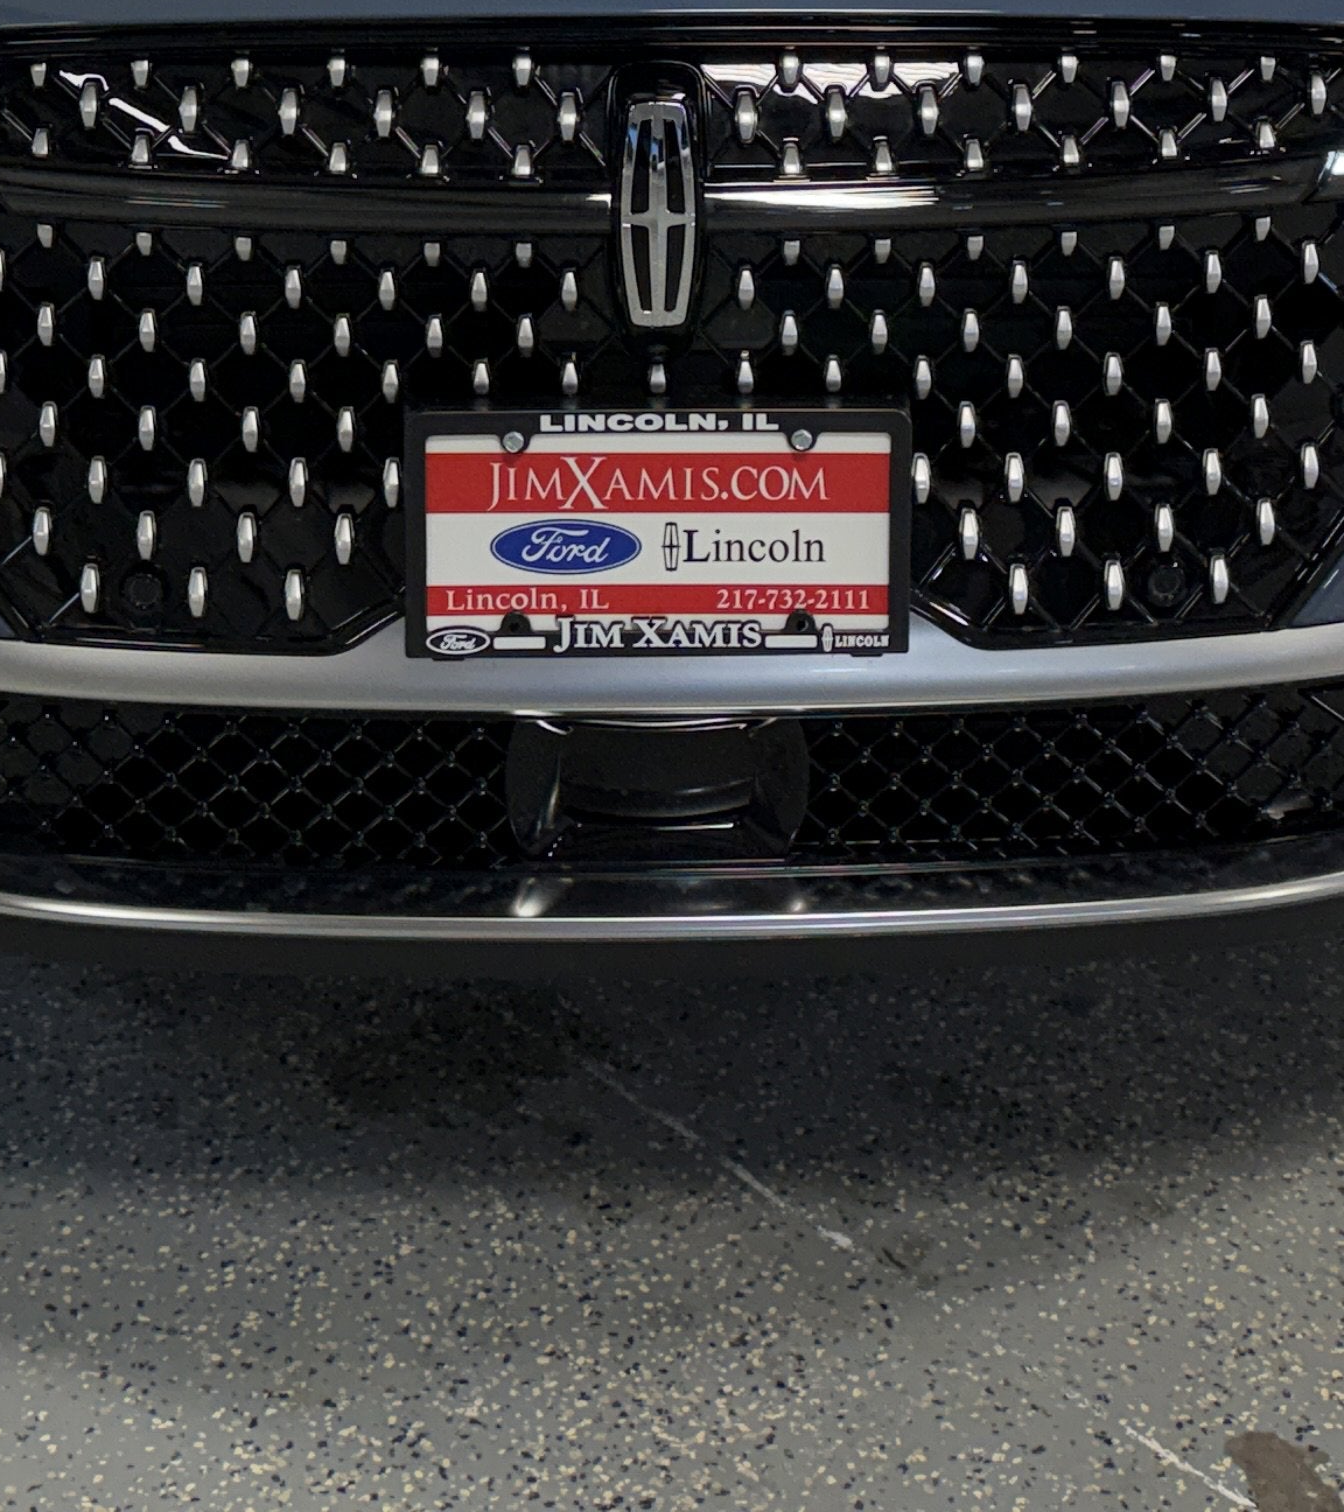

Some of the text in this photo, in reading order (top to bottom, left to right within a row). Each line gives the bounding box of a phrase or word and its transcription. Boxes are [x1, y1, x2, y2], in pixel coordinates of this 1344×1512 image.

[540, 413, 779, 432] LINCOLN, IL
[487, 456, 828, 511] JIMXAMIS.COM
[521, 526, 609, 564] Ford
[682, 528, 826, 563] Lincoln
[446, 587, 610, 612] Lincoln, IL
[716, 589, 870, 610] 217-732-2111
[440, 634, 477, 650] Ford
[553, 617, 762, 653] JIM XAMIS
[834, 634, 890, 648] LINCOLN
